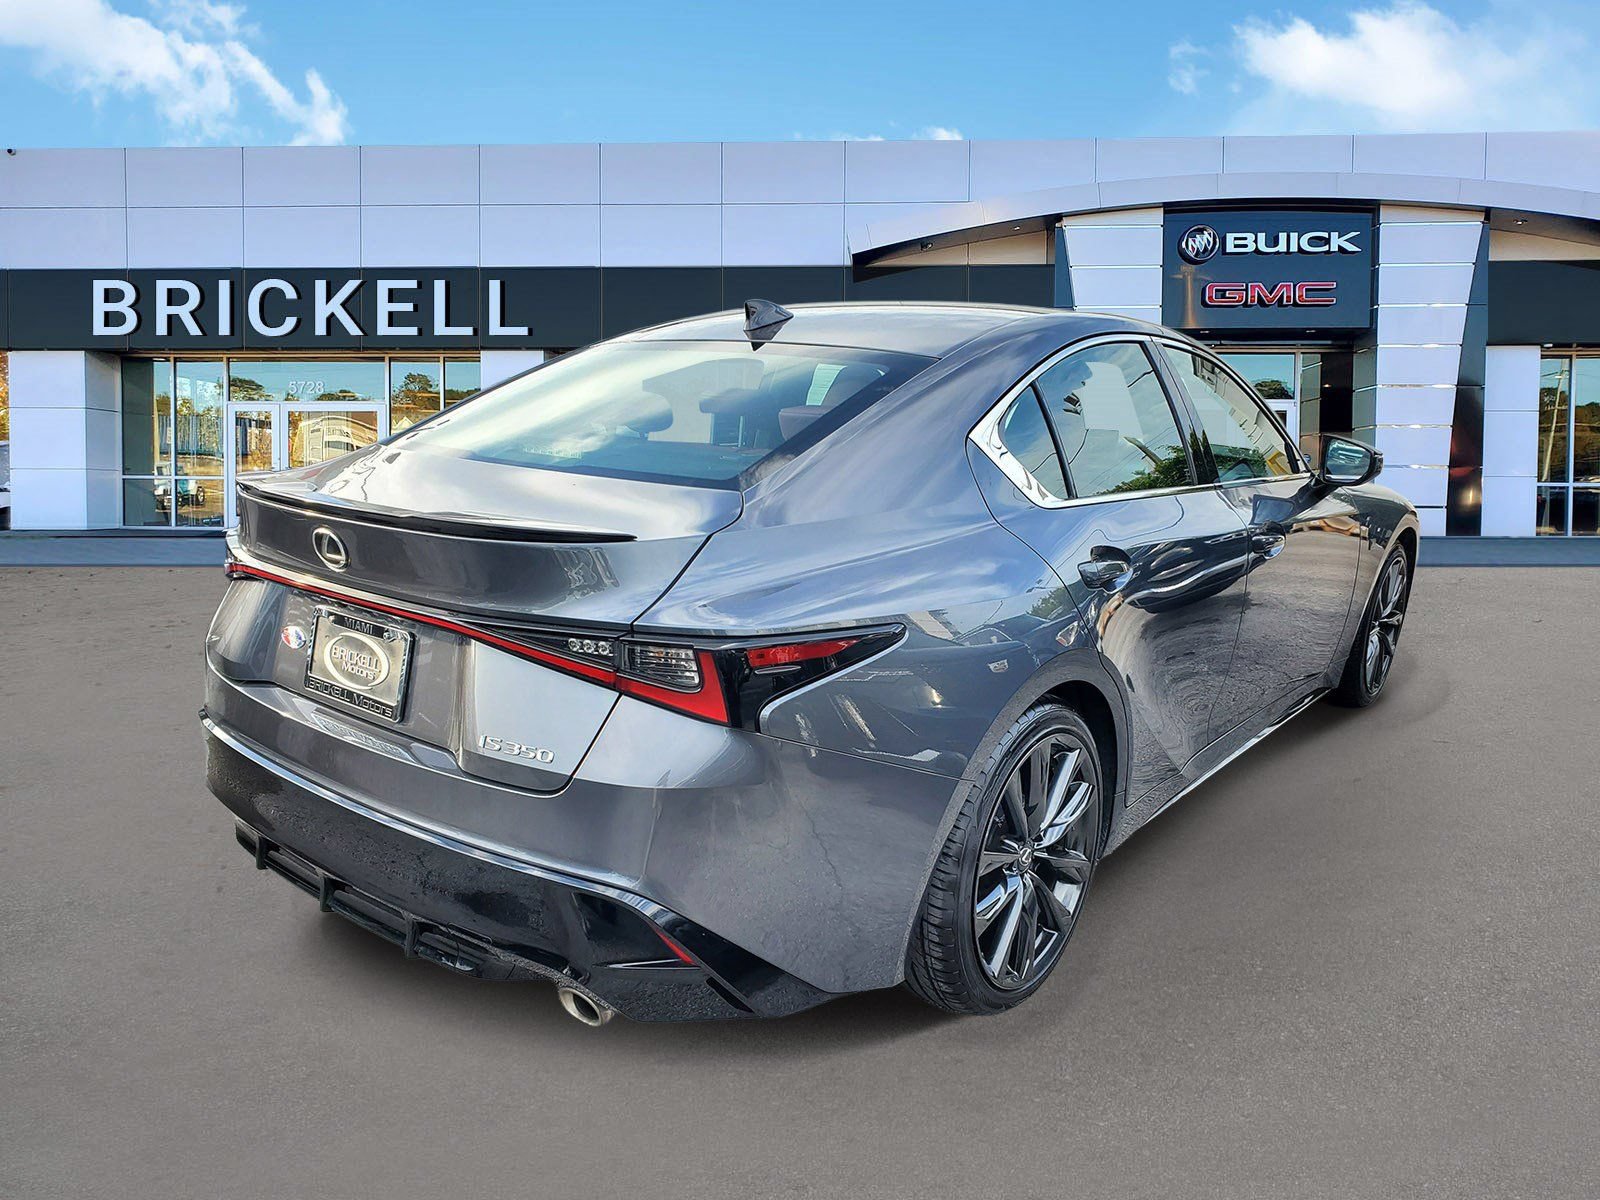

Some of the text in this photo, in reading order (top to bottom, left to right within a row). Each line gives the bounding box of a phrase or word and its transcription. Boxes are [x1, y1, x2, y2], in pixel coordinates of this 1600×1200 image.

[1225, 231, 1361, 253] BUICK
[1205, 281, 1337, 305] GMC
[92, 278, 531, 337] BRICKELL
[288, 380, 325, 394] 5728
[344, 617, 373, 635] MIAMI
[332, 645, 379, 671] BRICKELL
[308, 679, 350, 701] BRICKELL
[479, 735, 555, 764] IS 350
